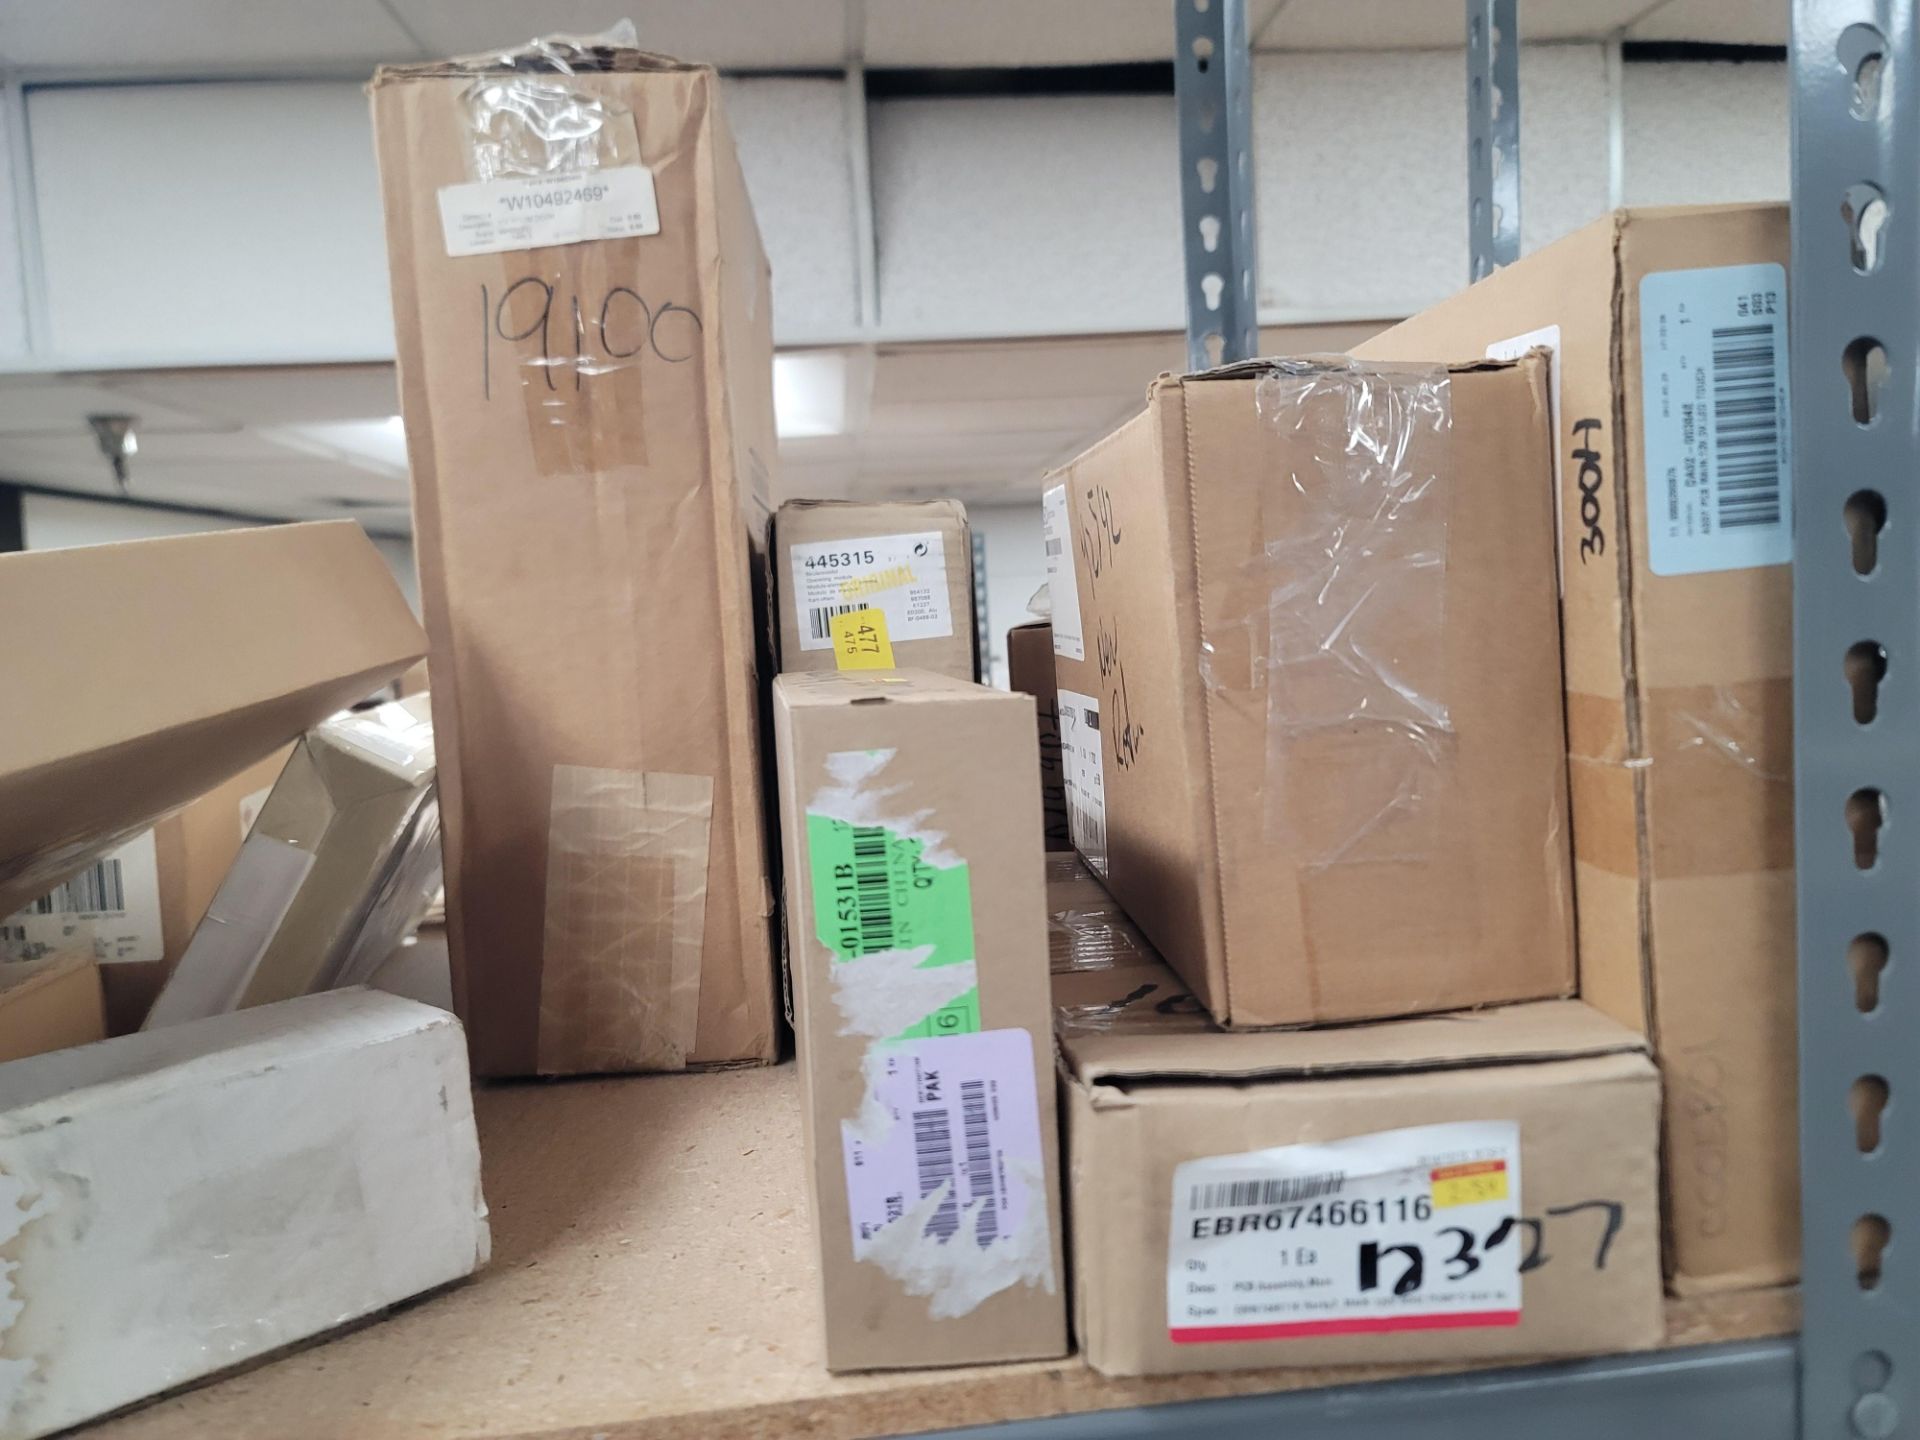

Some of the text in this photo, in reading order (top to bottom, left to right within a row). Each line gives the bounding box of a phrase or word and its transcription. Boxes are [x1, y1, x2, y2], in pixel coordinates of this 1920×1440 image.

[1572, 418, 1605, 565] 300H
[804, 550, 875, 570] 445315
[924, 1070, 942, 1101] PAK
[1190, 1194, 1433, 1240] EBR67466116
